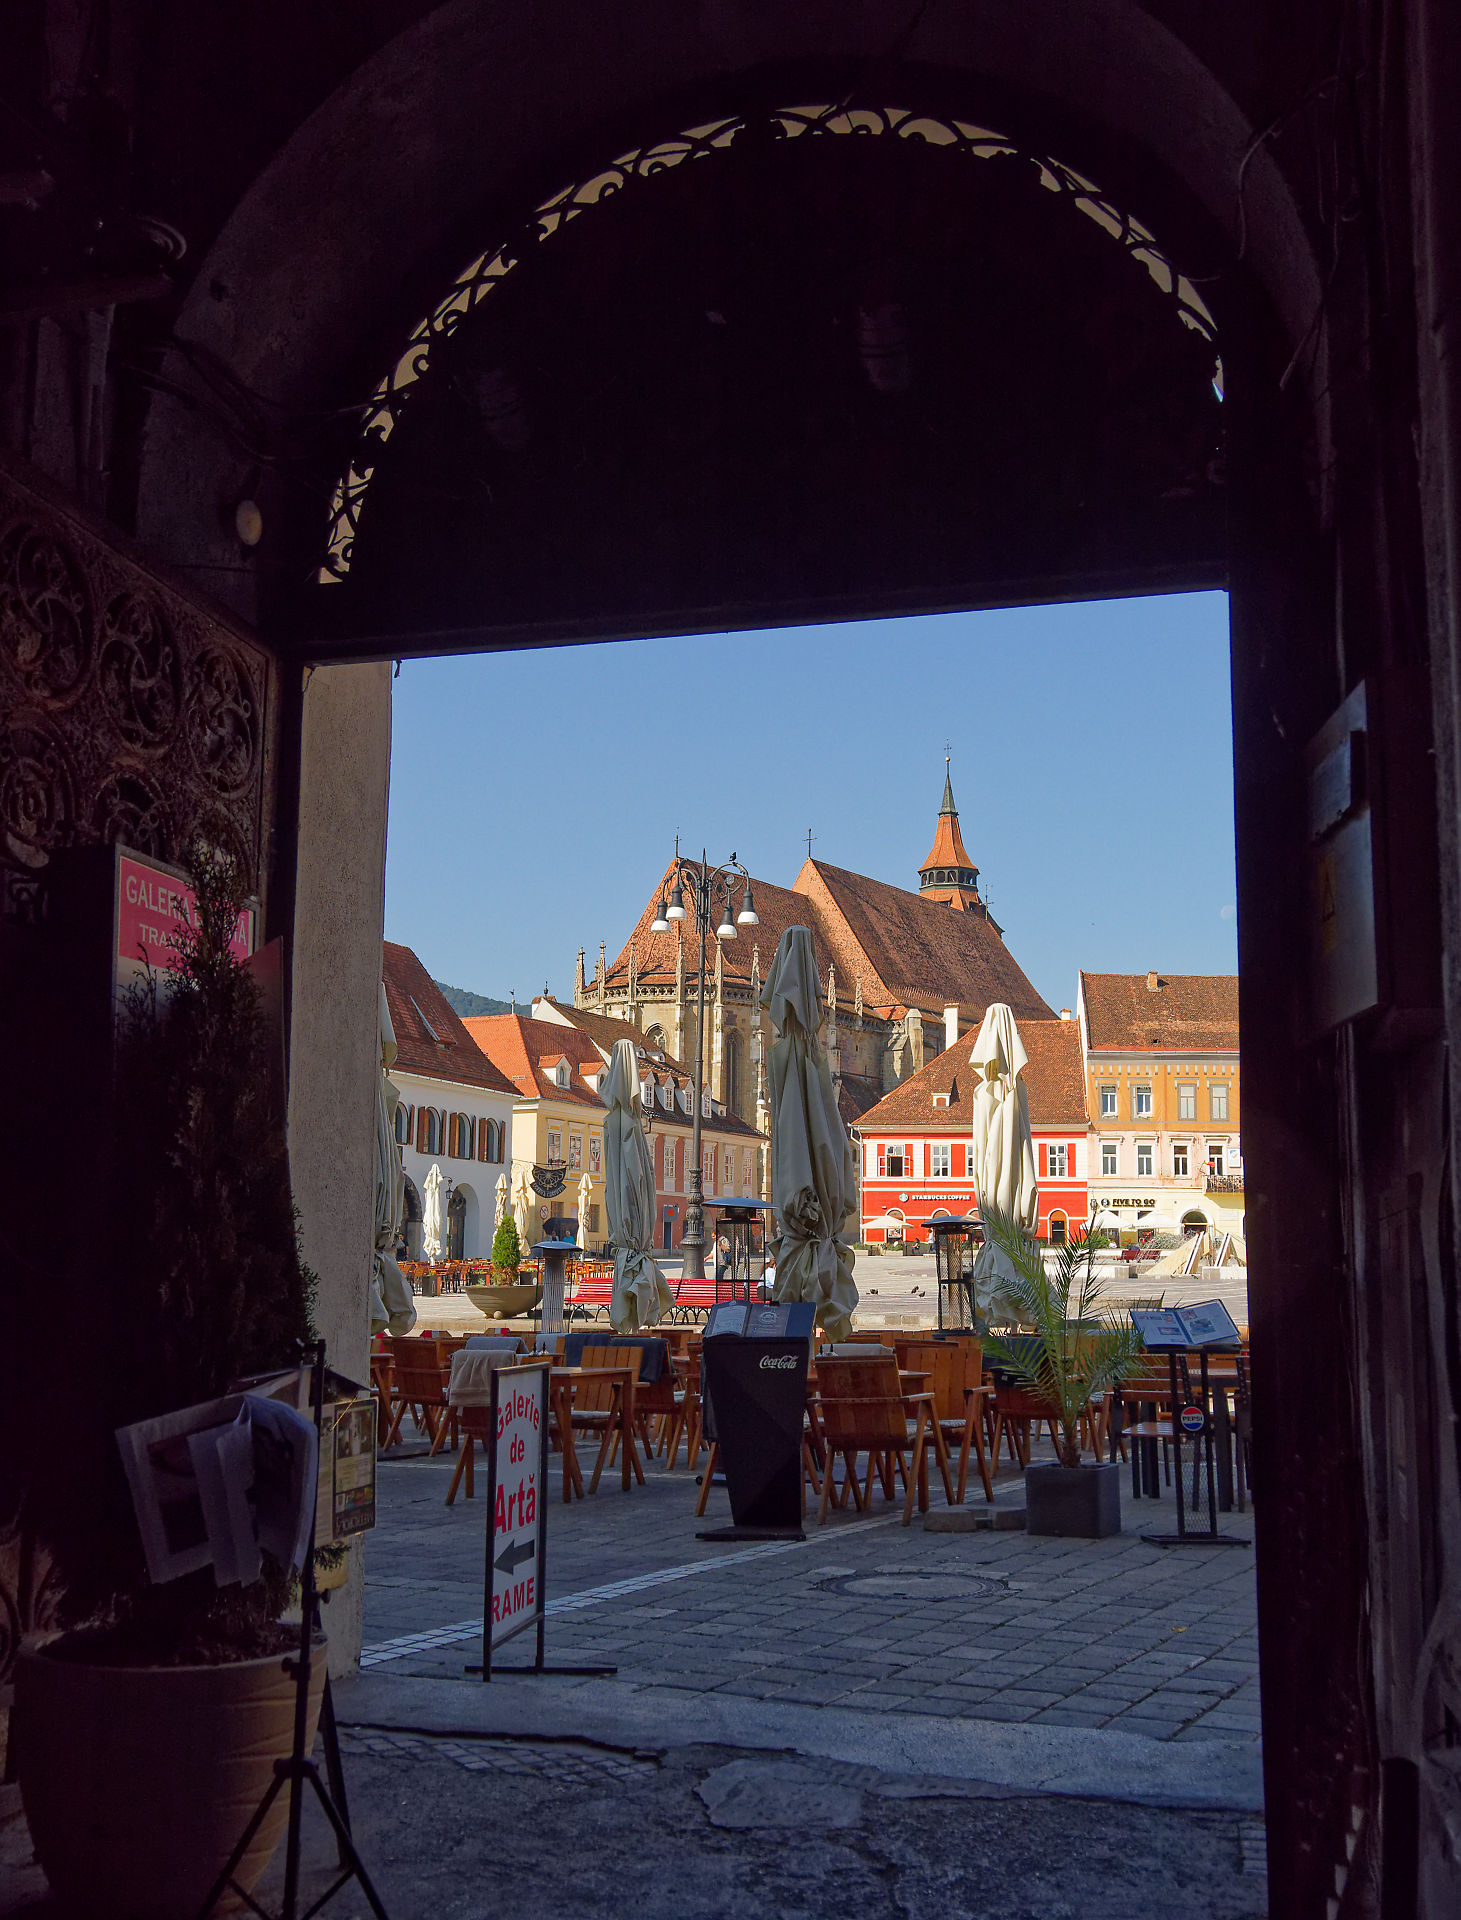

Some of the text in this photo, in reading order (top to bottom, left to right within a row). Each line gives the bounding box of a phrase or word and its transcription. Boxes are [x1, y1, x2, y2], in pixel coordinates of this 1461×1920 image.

[509, 1433, 525, 1464] de
[493, 1473, 536, 1537] Artă
[491, 1576, 535, 1625] RAME
